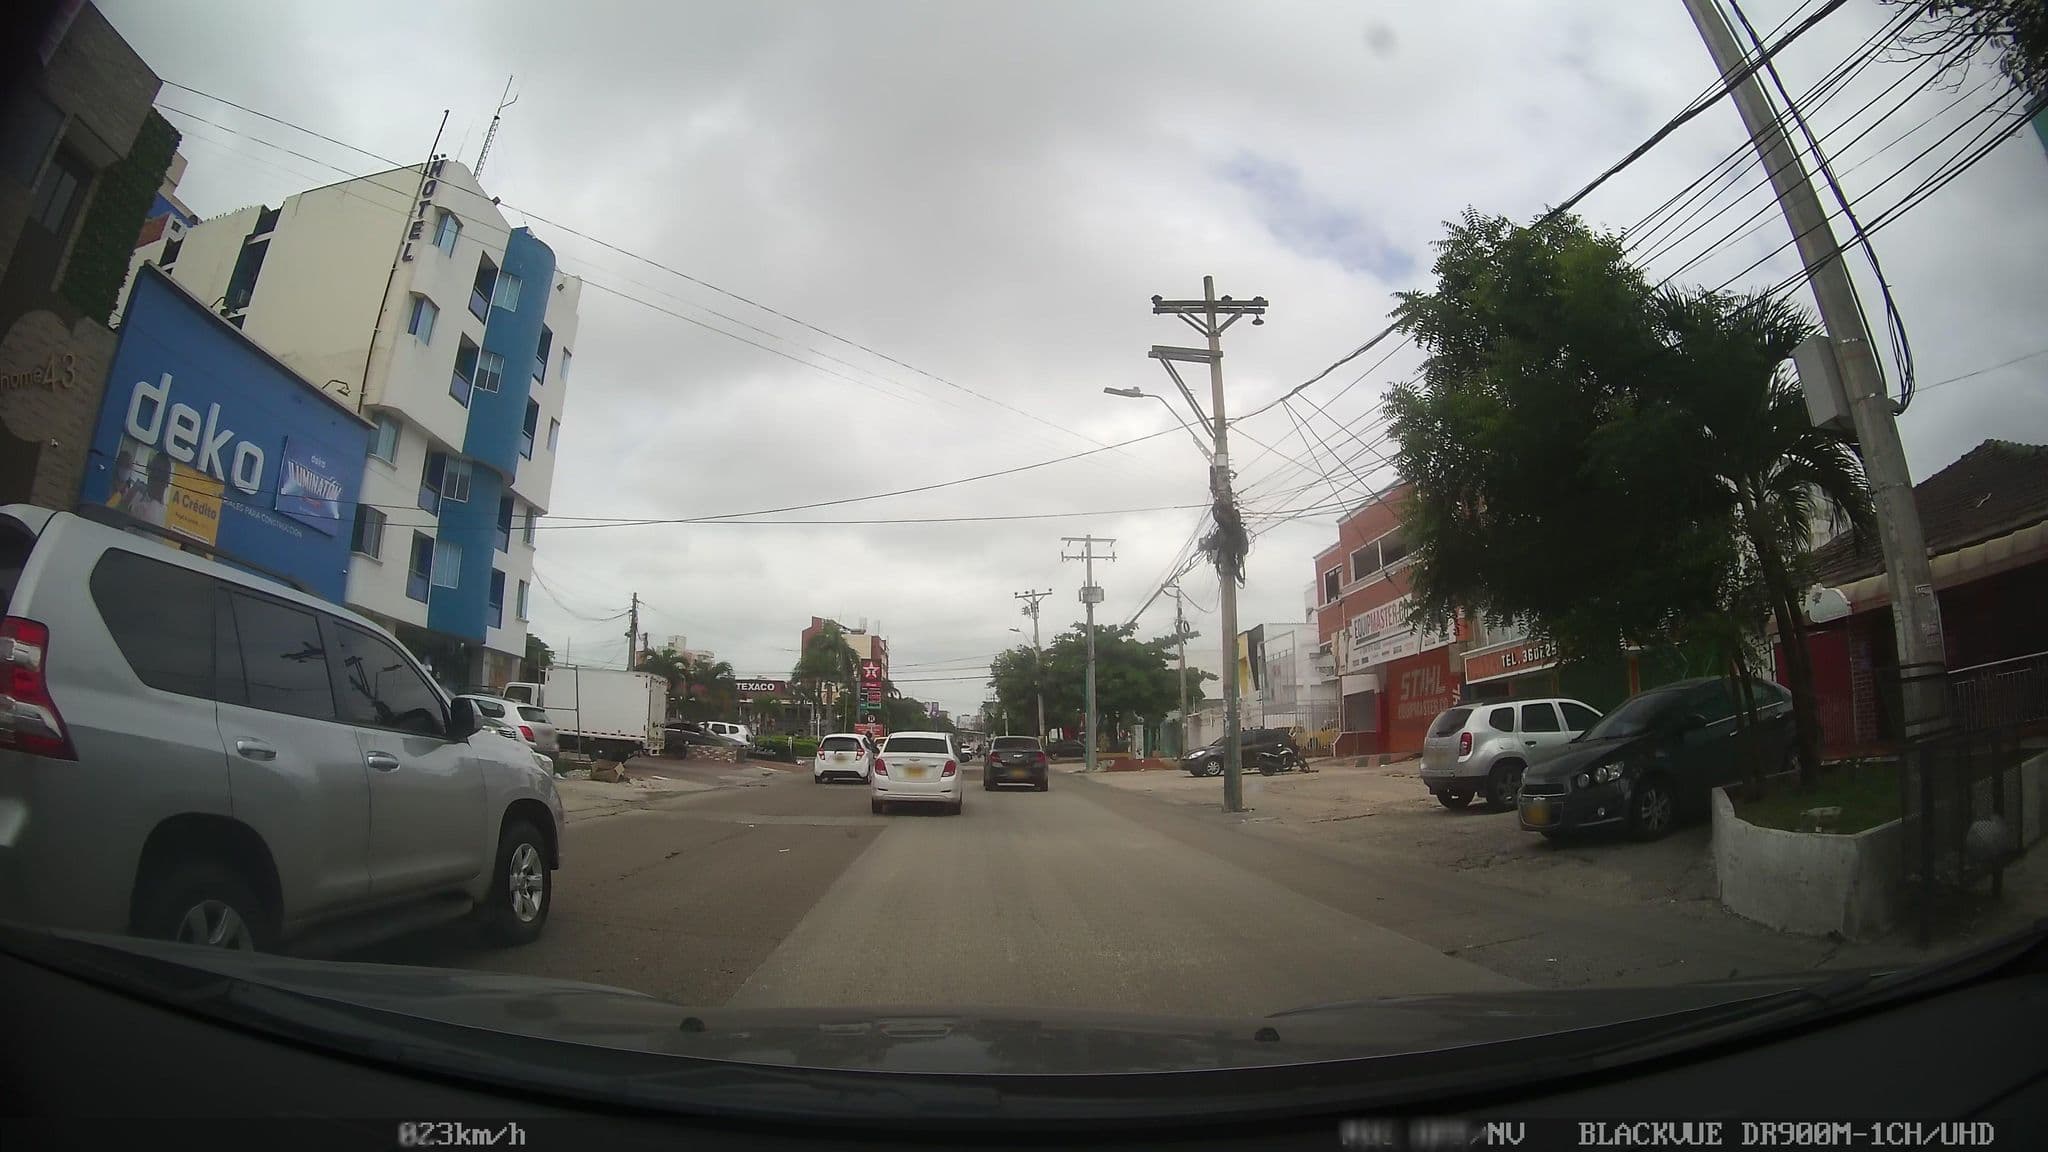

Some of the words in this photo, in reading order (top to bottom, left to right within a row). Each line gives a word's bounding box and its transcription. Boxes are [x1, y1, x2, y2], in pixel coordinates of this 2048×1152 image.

[402, 159, 446, 261] HOTEL
[125, 372, 265, 495] deko
[173, 490, 180, 504] A
[182, 494, 217, 521] Crédito
[1501, 651, 1521, 668] TEL.
[736, 682, 775, 691] TEXACO
[1400, 664, 1447, 701] STIHL
